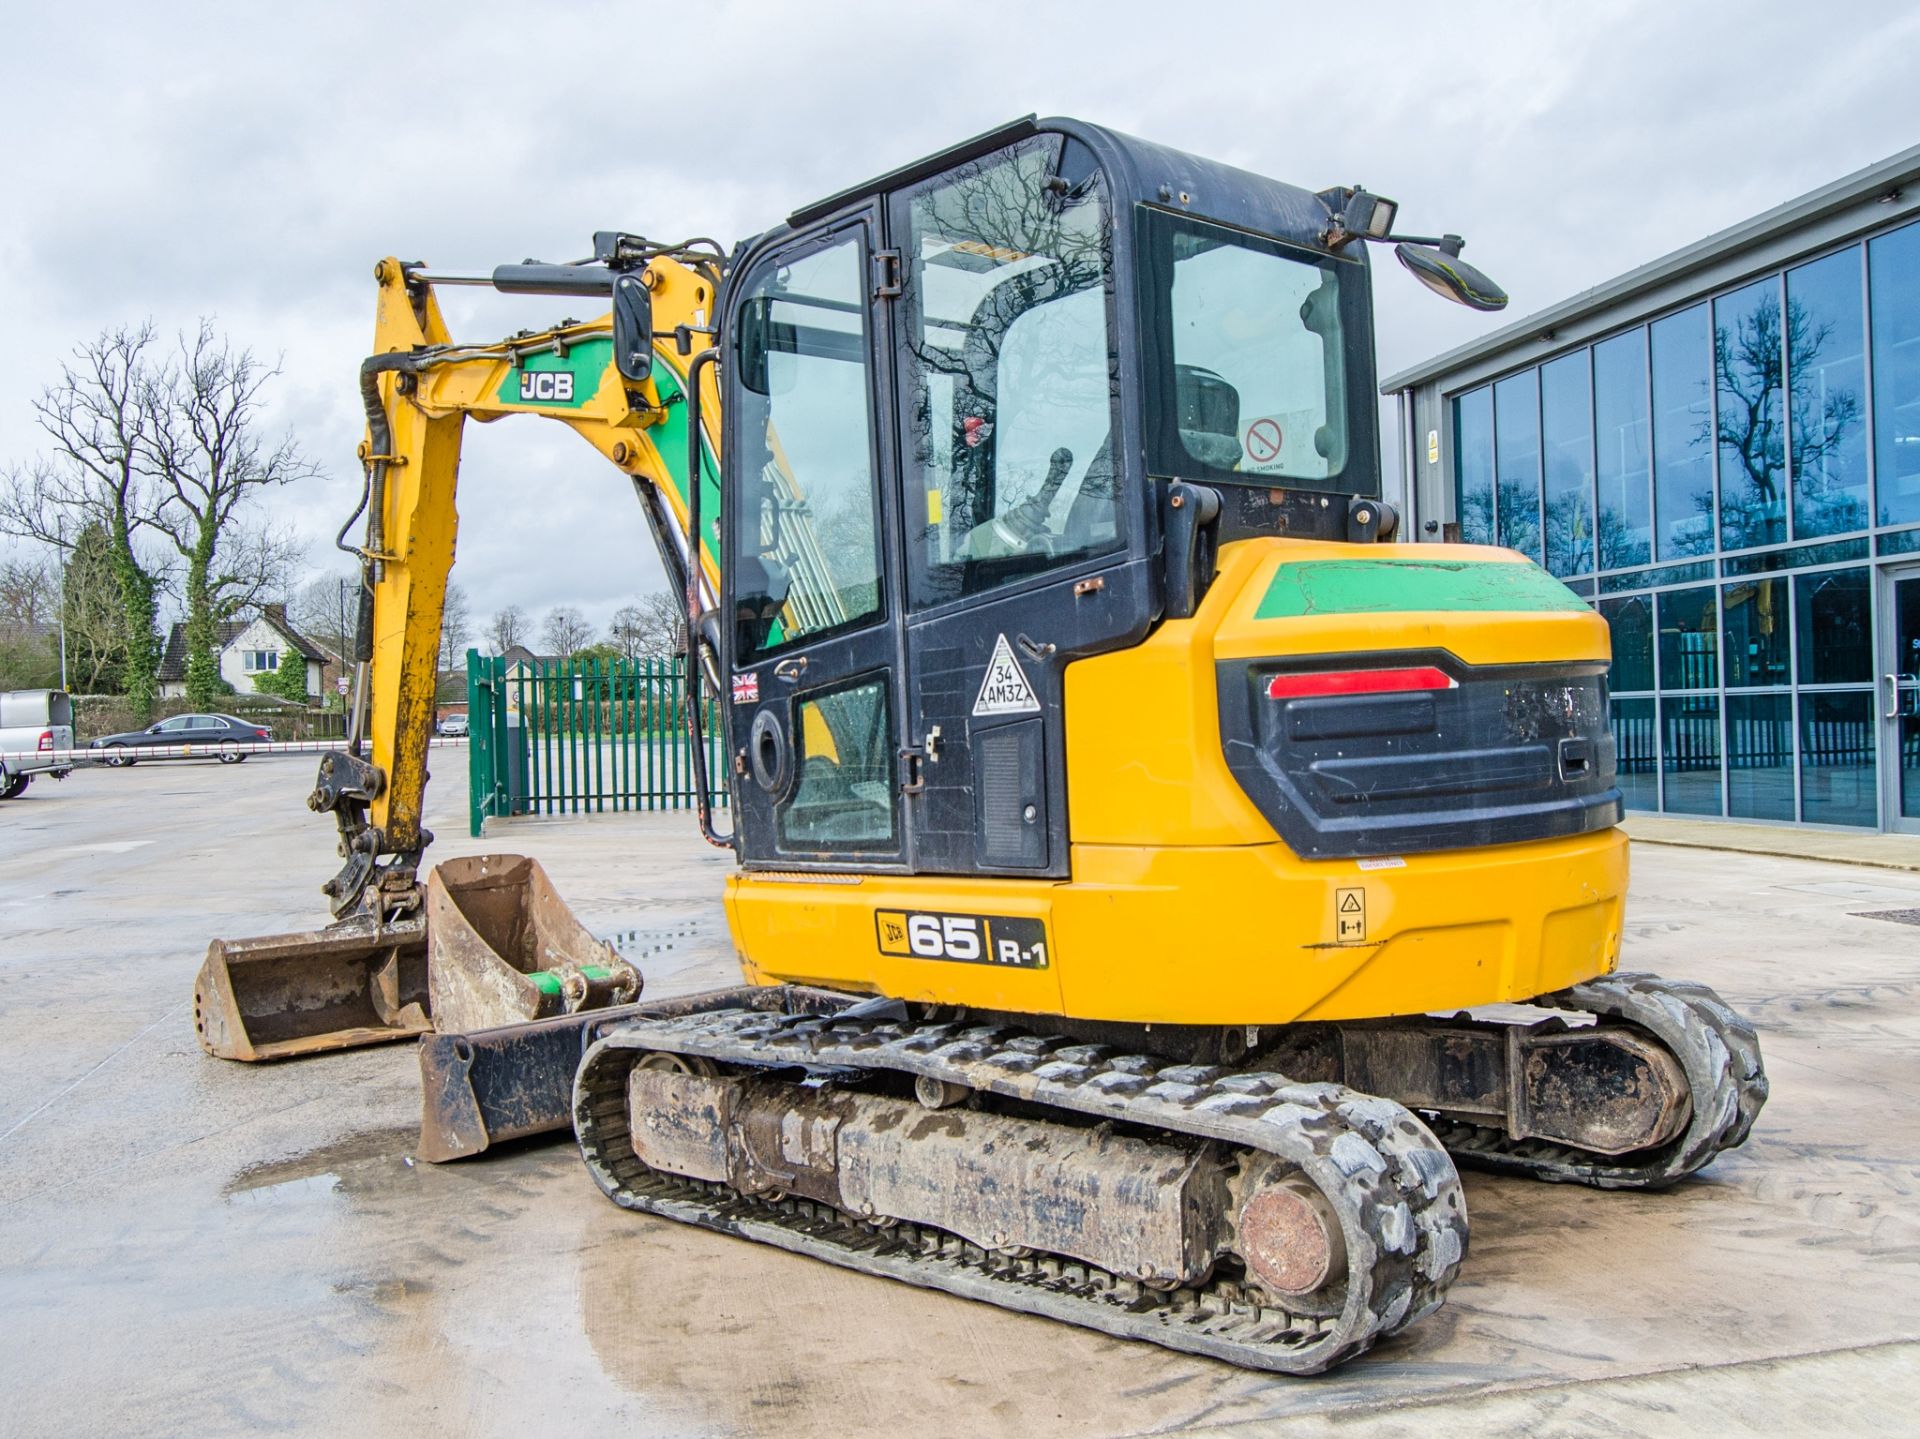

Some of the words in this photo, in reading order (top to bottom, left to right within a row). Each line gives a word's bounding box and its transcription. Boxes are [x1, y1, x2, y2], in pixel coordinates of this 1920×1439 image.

[521, 372, 573, 399] JCB
[1257, 463, 1284, 472] SMOKING
[995, 665, 1012, 683] 34
[988, 684, 1023, 704] AM3Z
[886, 923, 903, 941] JCB
[908, 915, 980, 960] 65
[998, 940, 1047, 966] R-1
